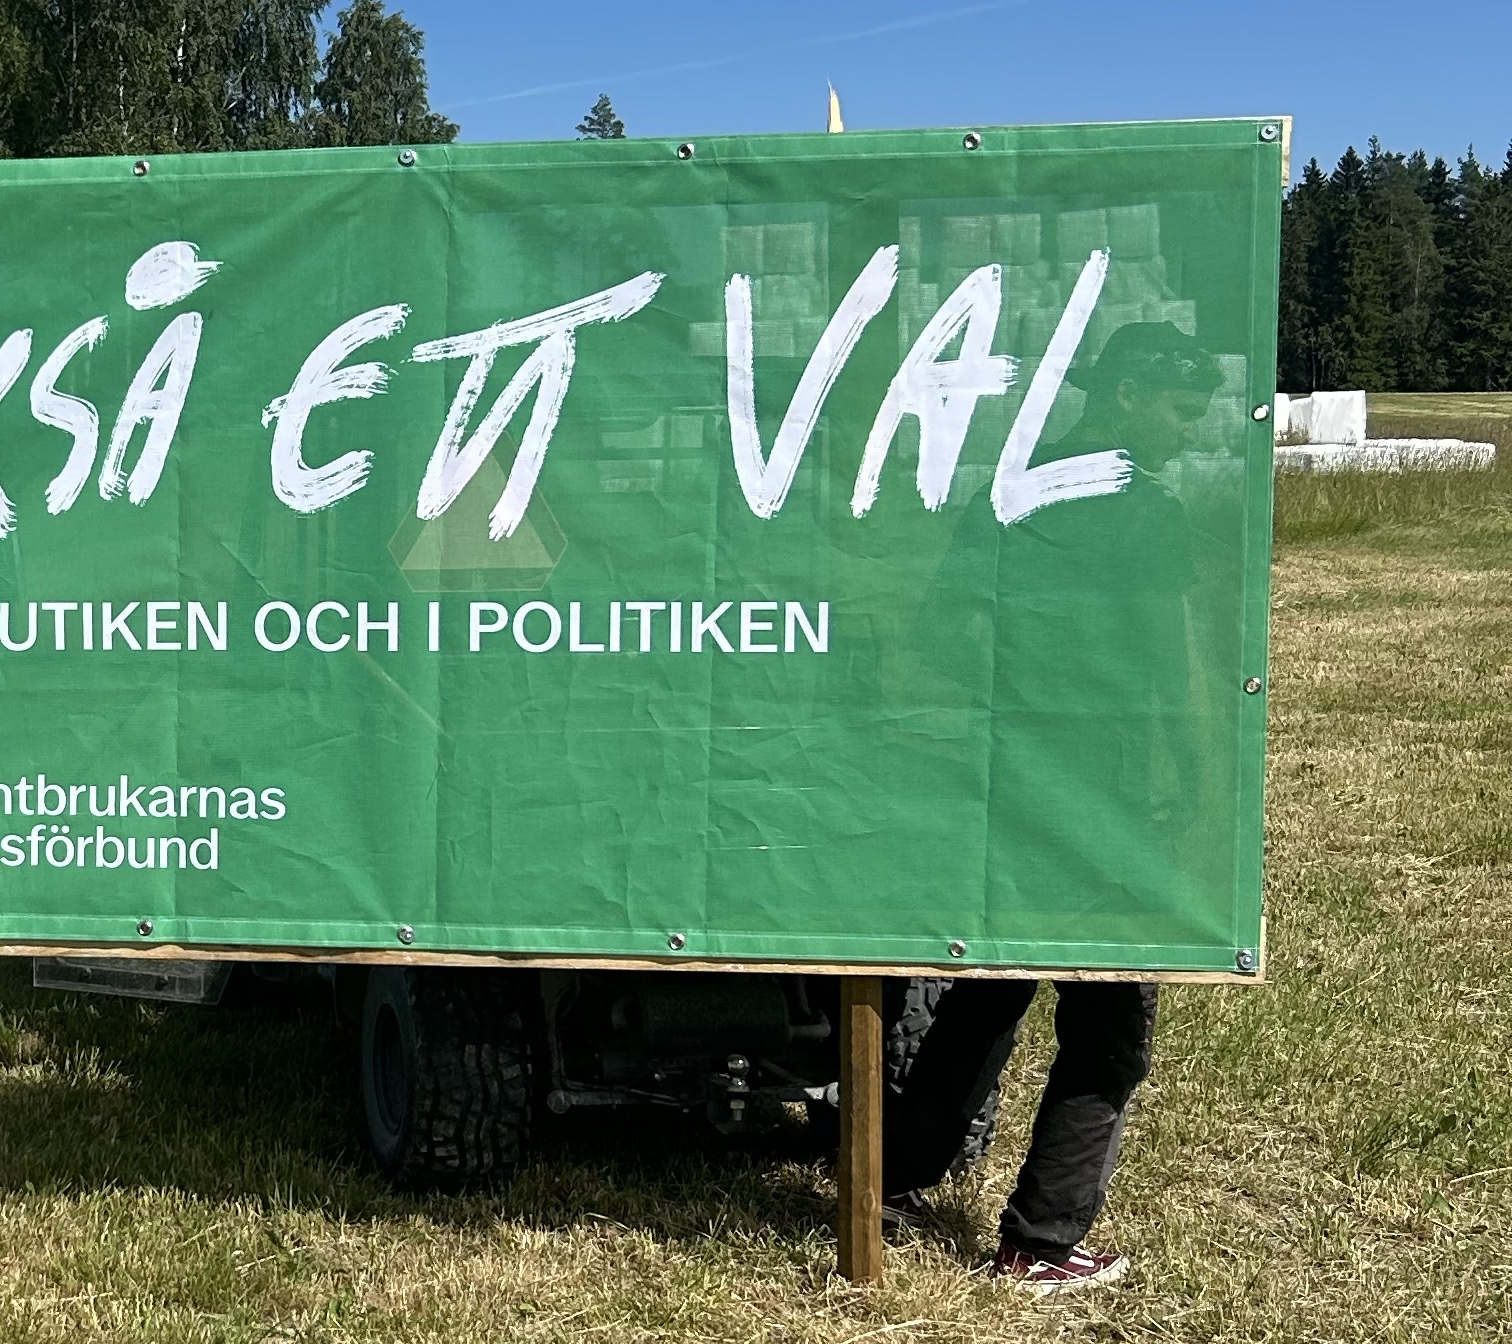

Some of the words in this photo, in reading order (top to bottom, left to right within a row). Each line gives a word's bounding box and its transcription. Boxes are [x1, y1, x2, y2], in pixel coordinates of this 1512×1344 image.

[260, 269, 667, 540] ETT
[723, 243, 1135, 526] VAL
[254, 600, 399, 653] OCH
[428, 601, 441, 653] I
[469, 600, 830, 654] POLITIKEN
